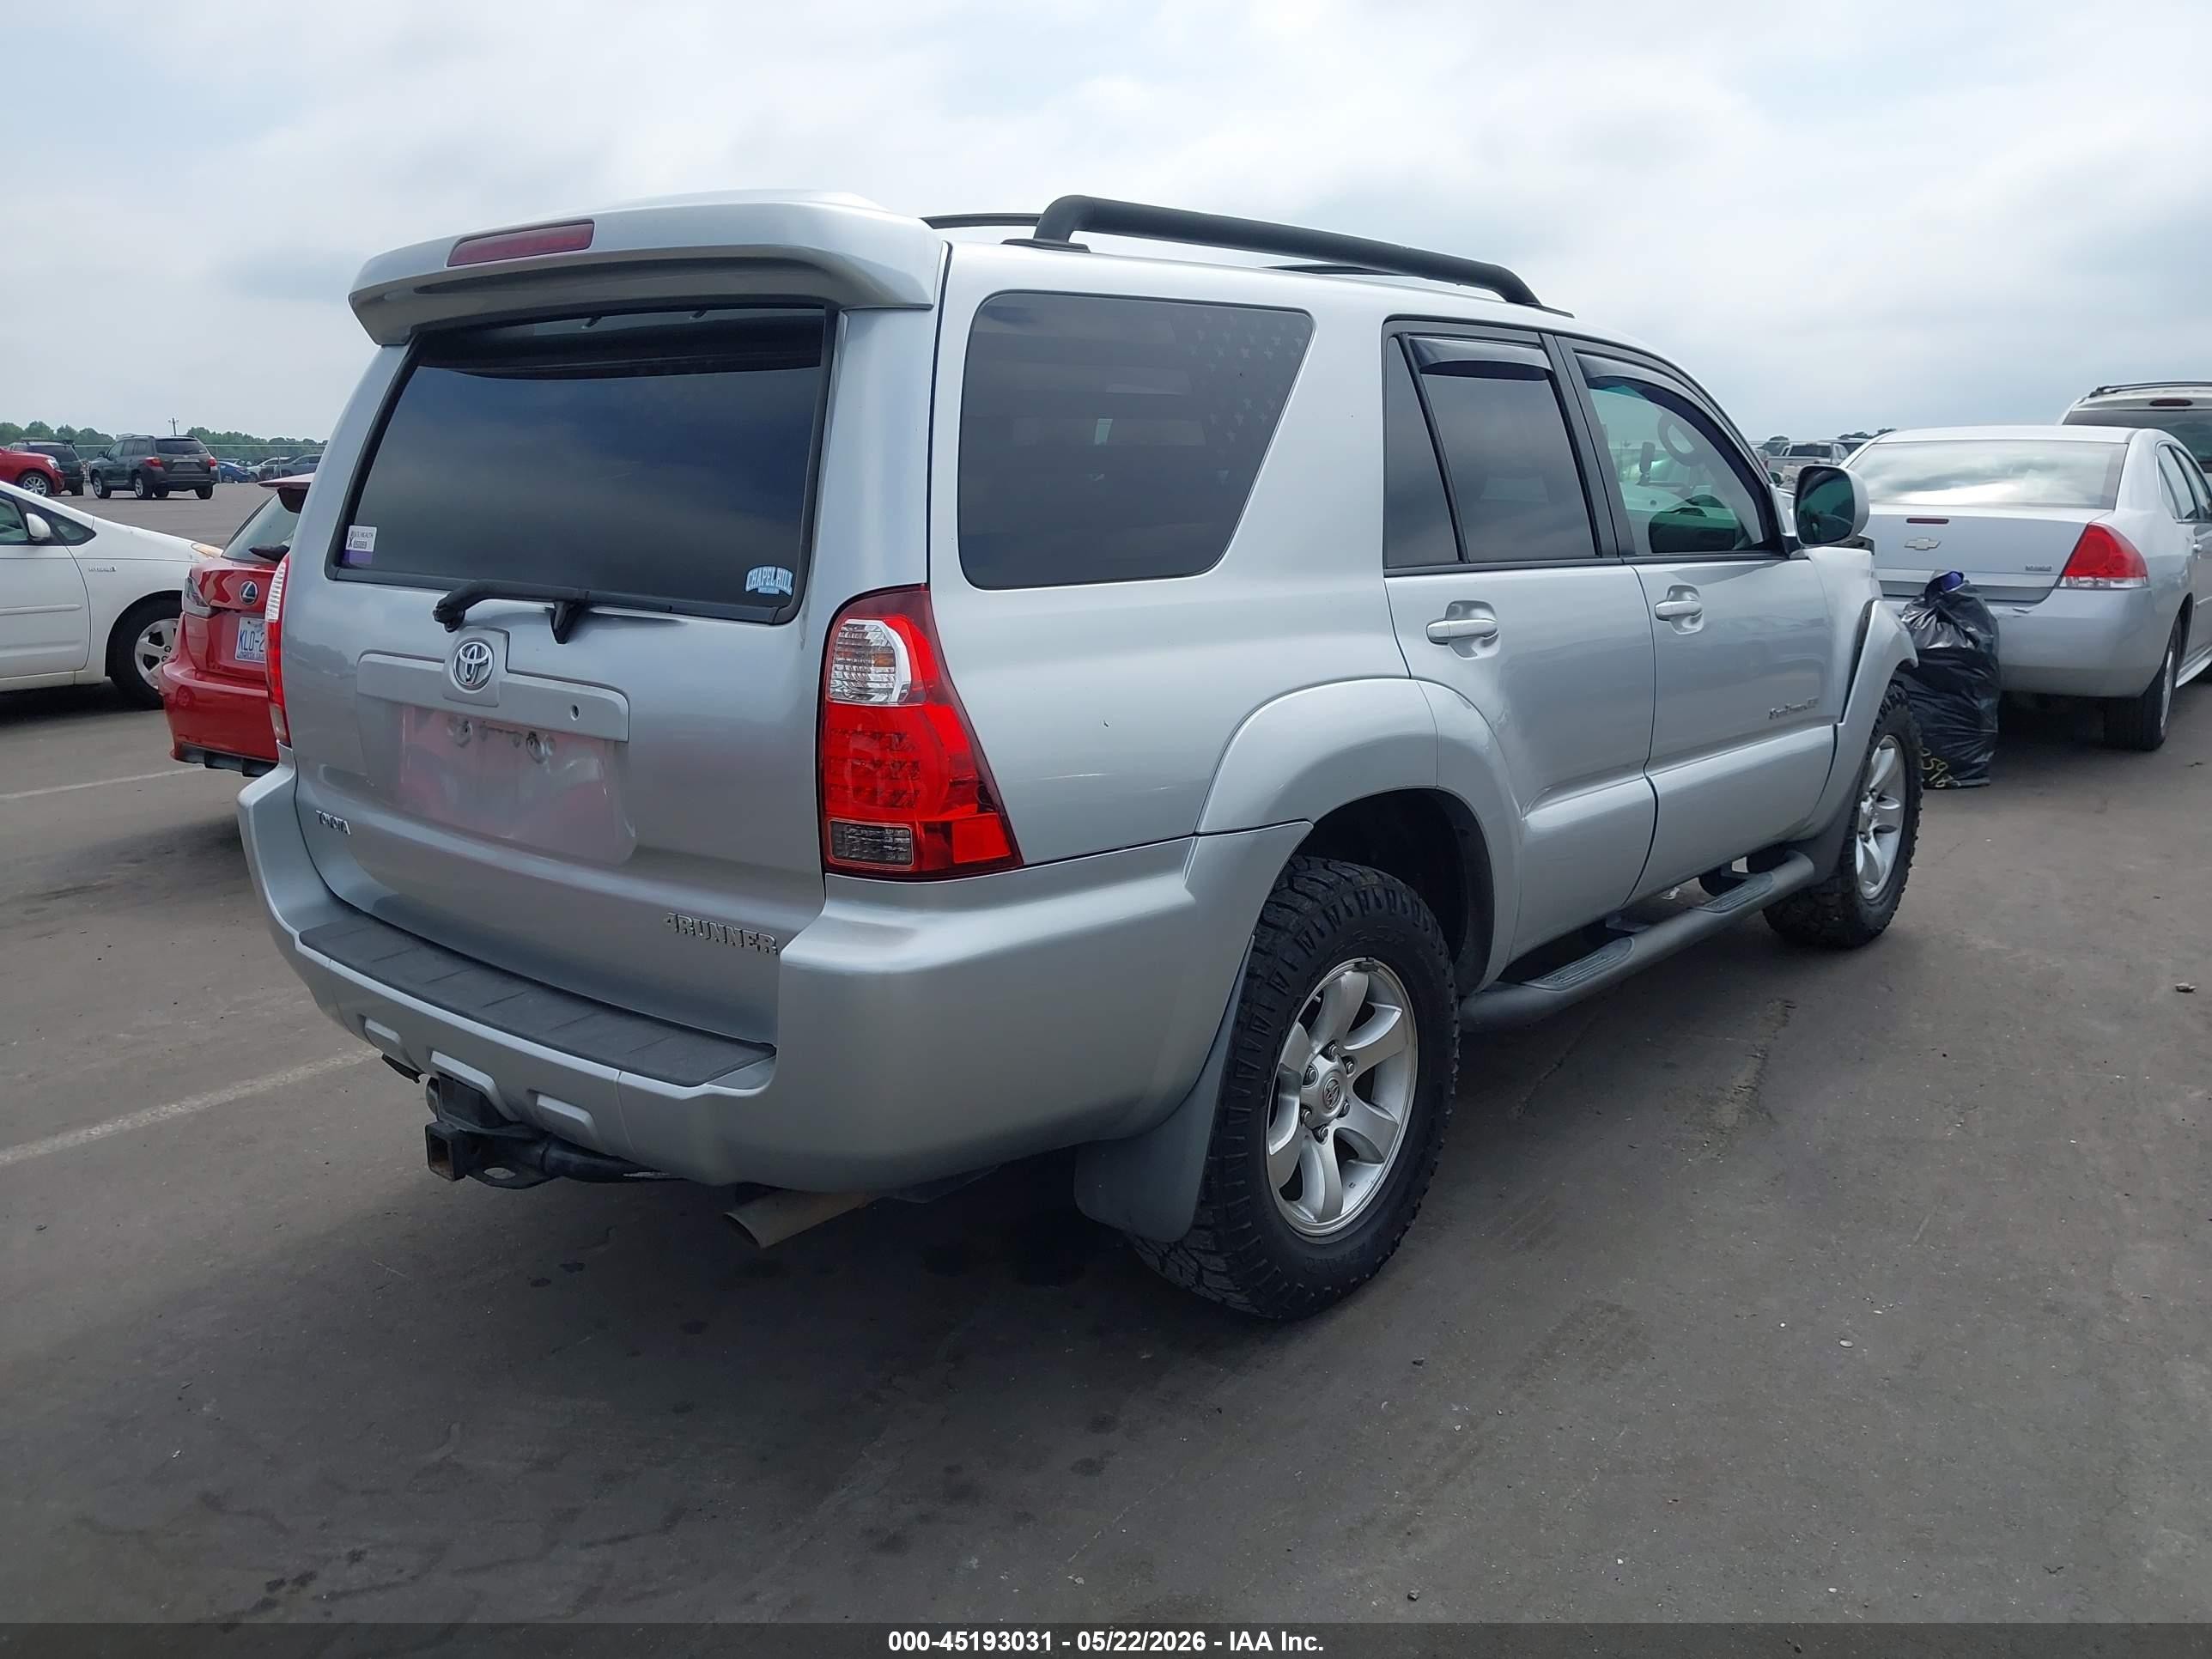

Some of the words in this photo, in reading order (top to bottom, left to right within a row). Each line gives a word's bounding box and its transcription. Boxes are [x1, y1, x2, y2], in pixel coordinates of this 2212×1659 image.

[745, 567, 775, 592] CHAPEL
[775, 568, 793, 595] HILL
[315, 810, 351, 836] TOYOTA
[665, 912, 778, 955] 4RUNNER
